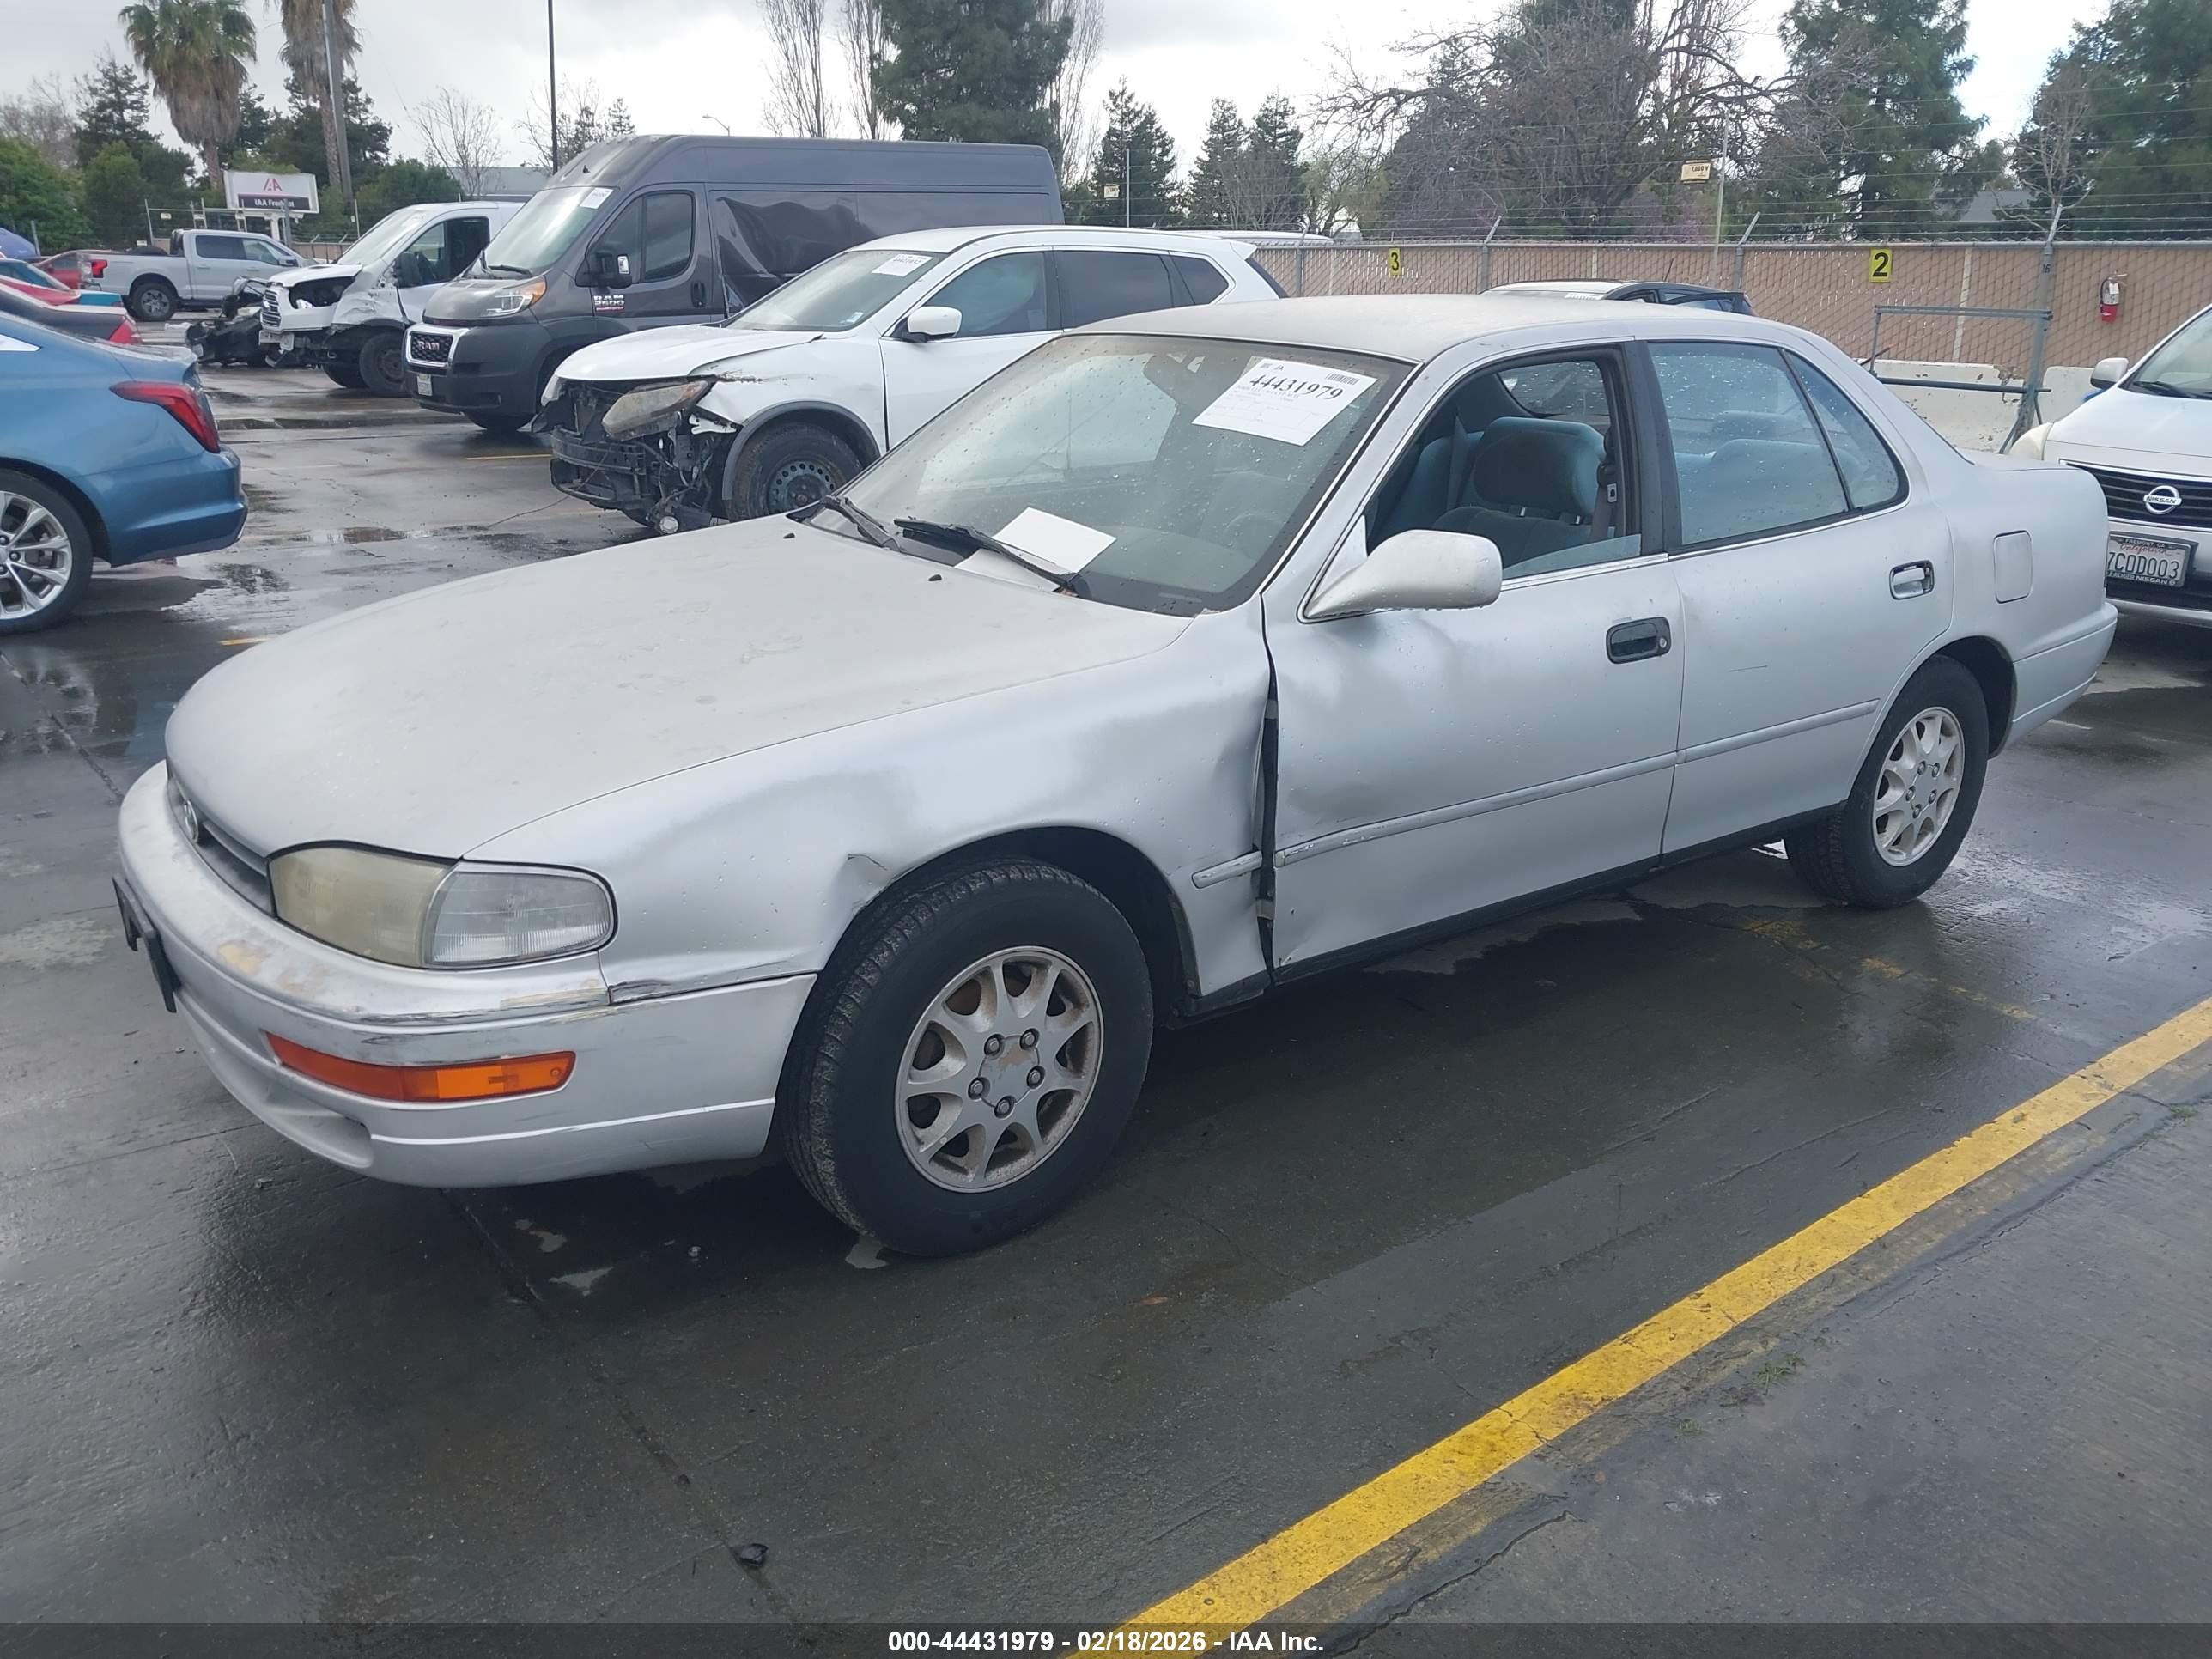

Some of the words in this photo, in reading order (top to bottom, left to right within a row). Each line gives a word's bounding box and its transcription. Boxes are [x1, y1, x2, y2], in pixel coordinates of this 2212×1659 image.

[1391, 252, 1399, 271] 3
[1873, 252, 1889, 276] 2
[417, 341, 440, 350] RAM
[1249, 374, 1344, 400] 44431979
[2146, 495, 2177, 504] NISSAN
[2136, 575, 2168, 585] NISSAN
